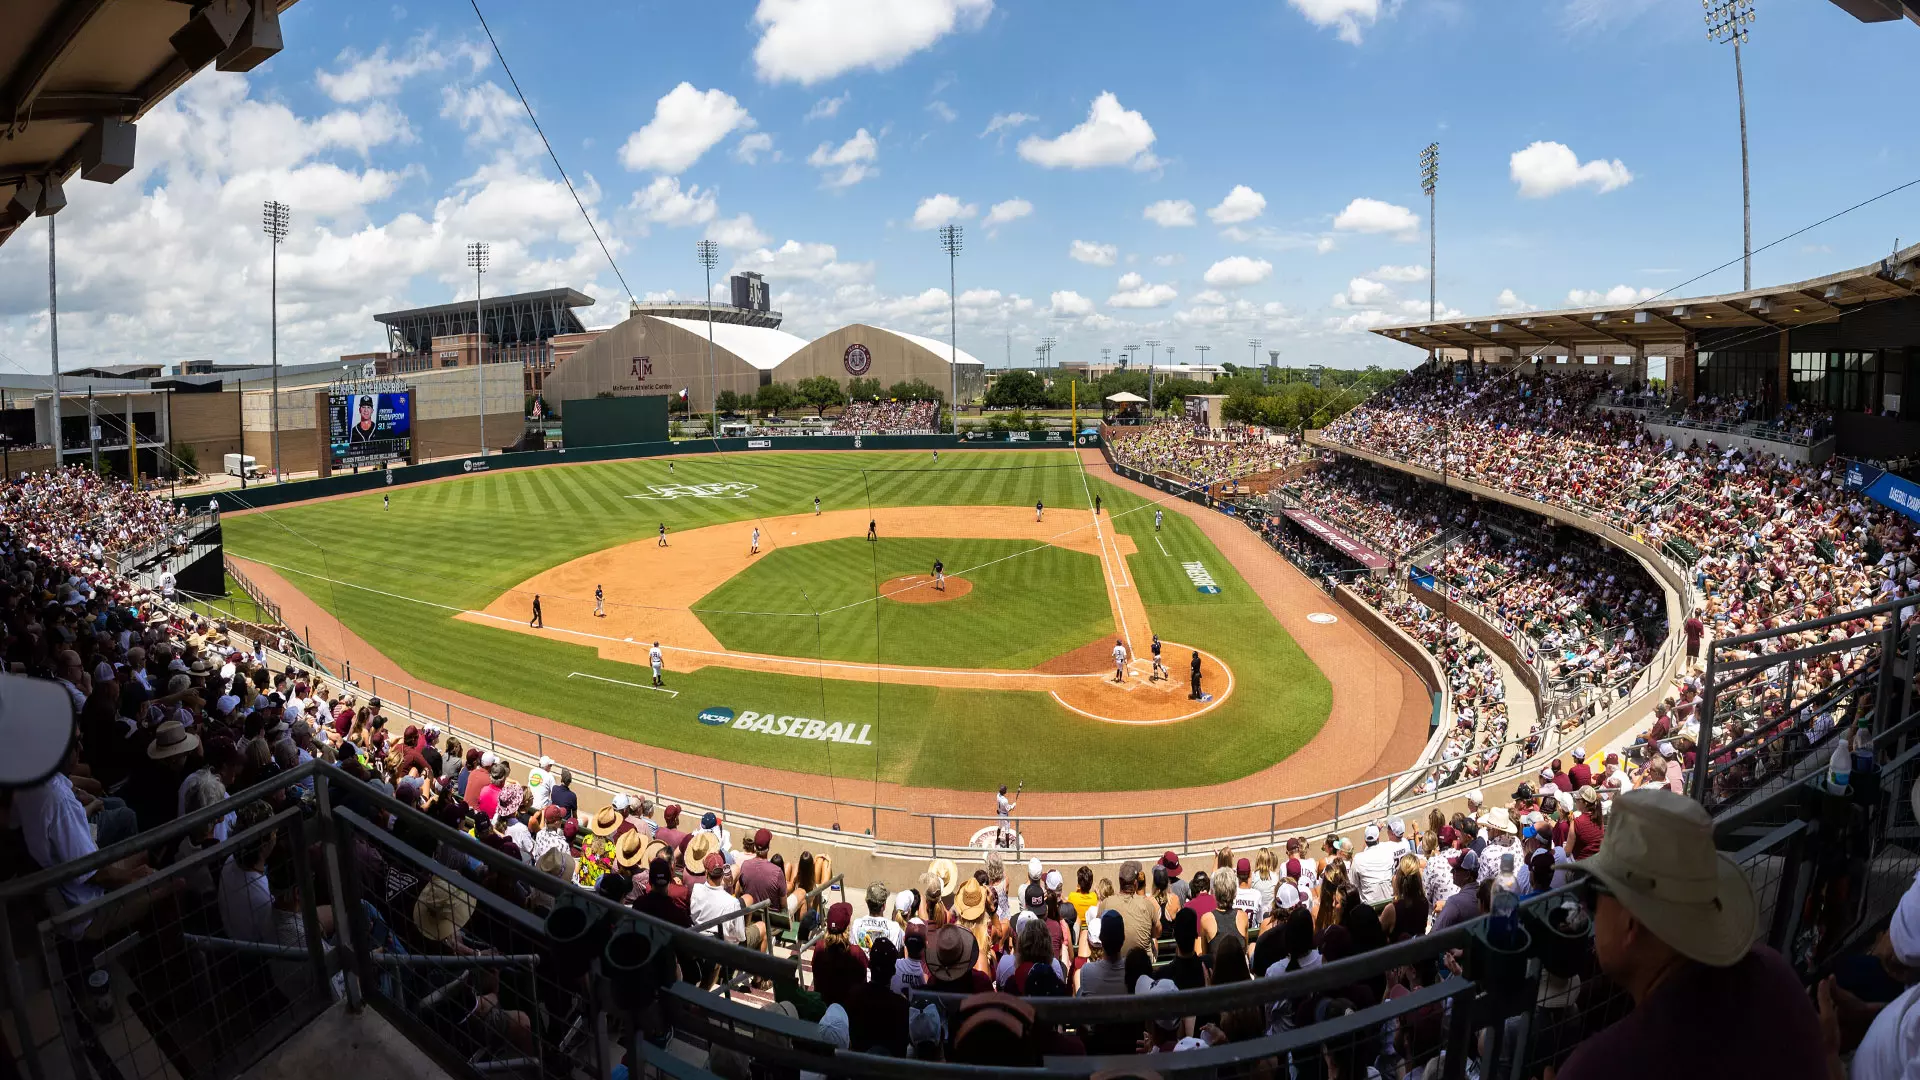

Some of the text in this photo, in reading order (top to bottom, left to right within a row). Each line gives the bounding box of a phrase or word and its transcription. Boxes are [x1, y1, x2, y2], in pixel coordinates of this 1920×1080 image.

[378, 412, 405, 421] THOMPSON
[378, 422, 385, 430] 31
[700, 712, 731, 724] NCAA
[732, 710, 872, 746] BASEBALL
